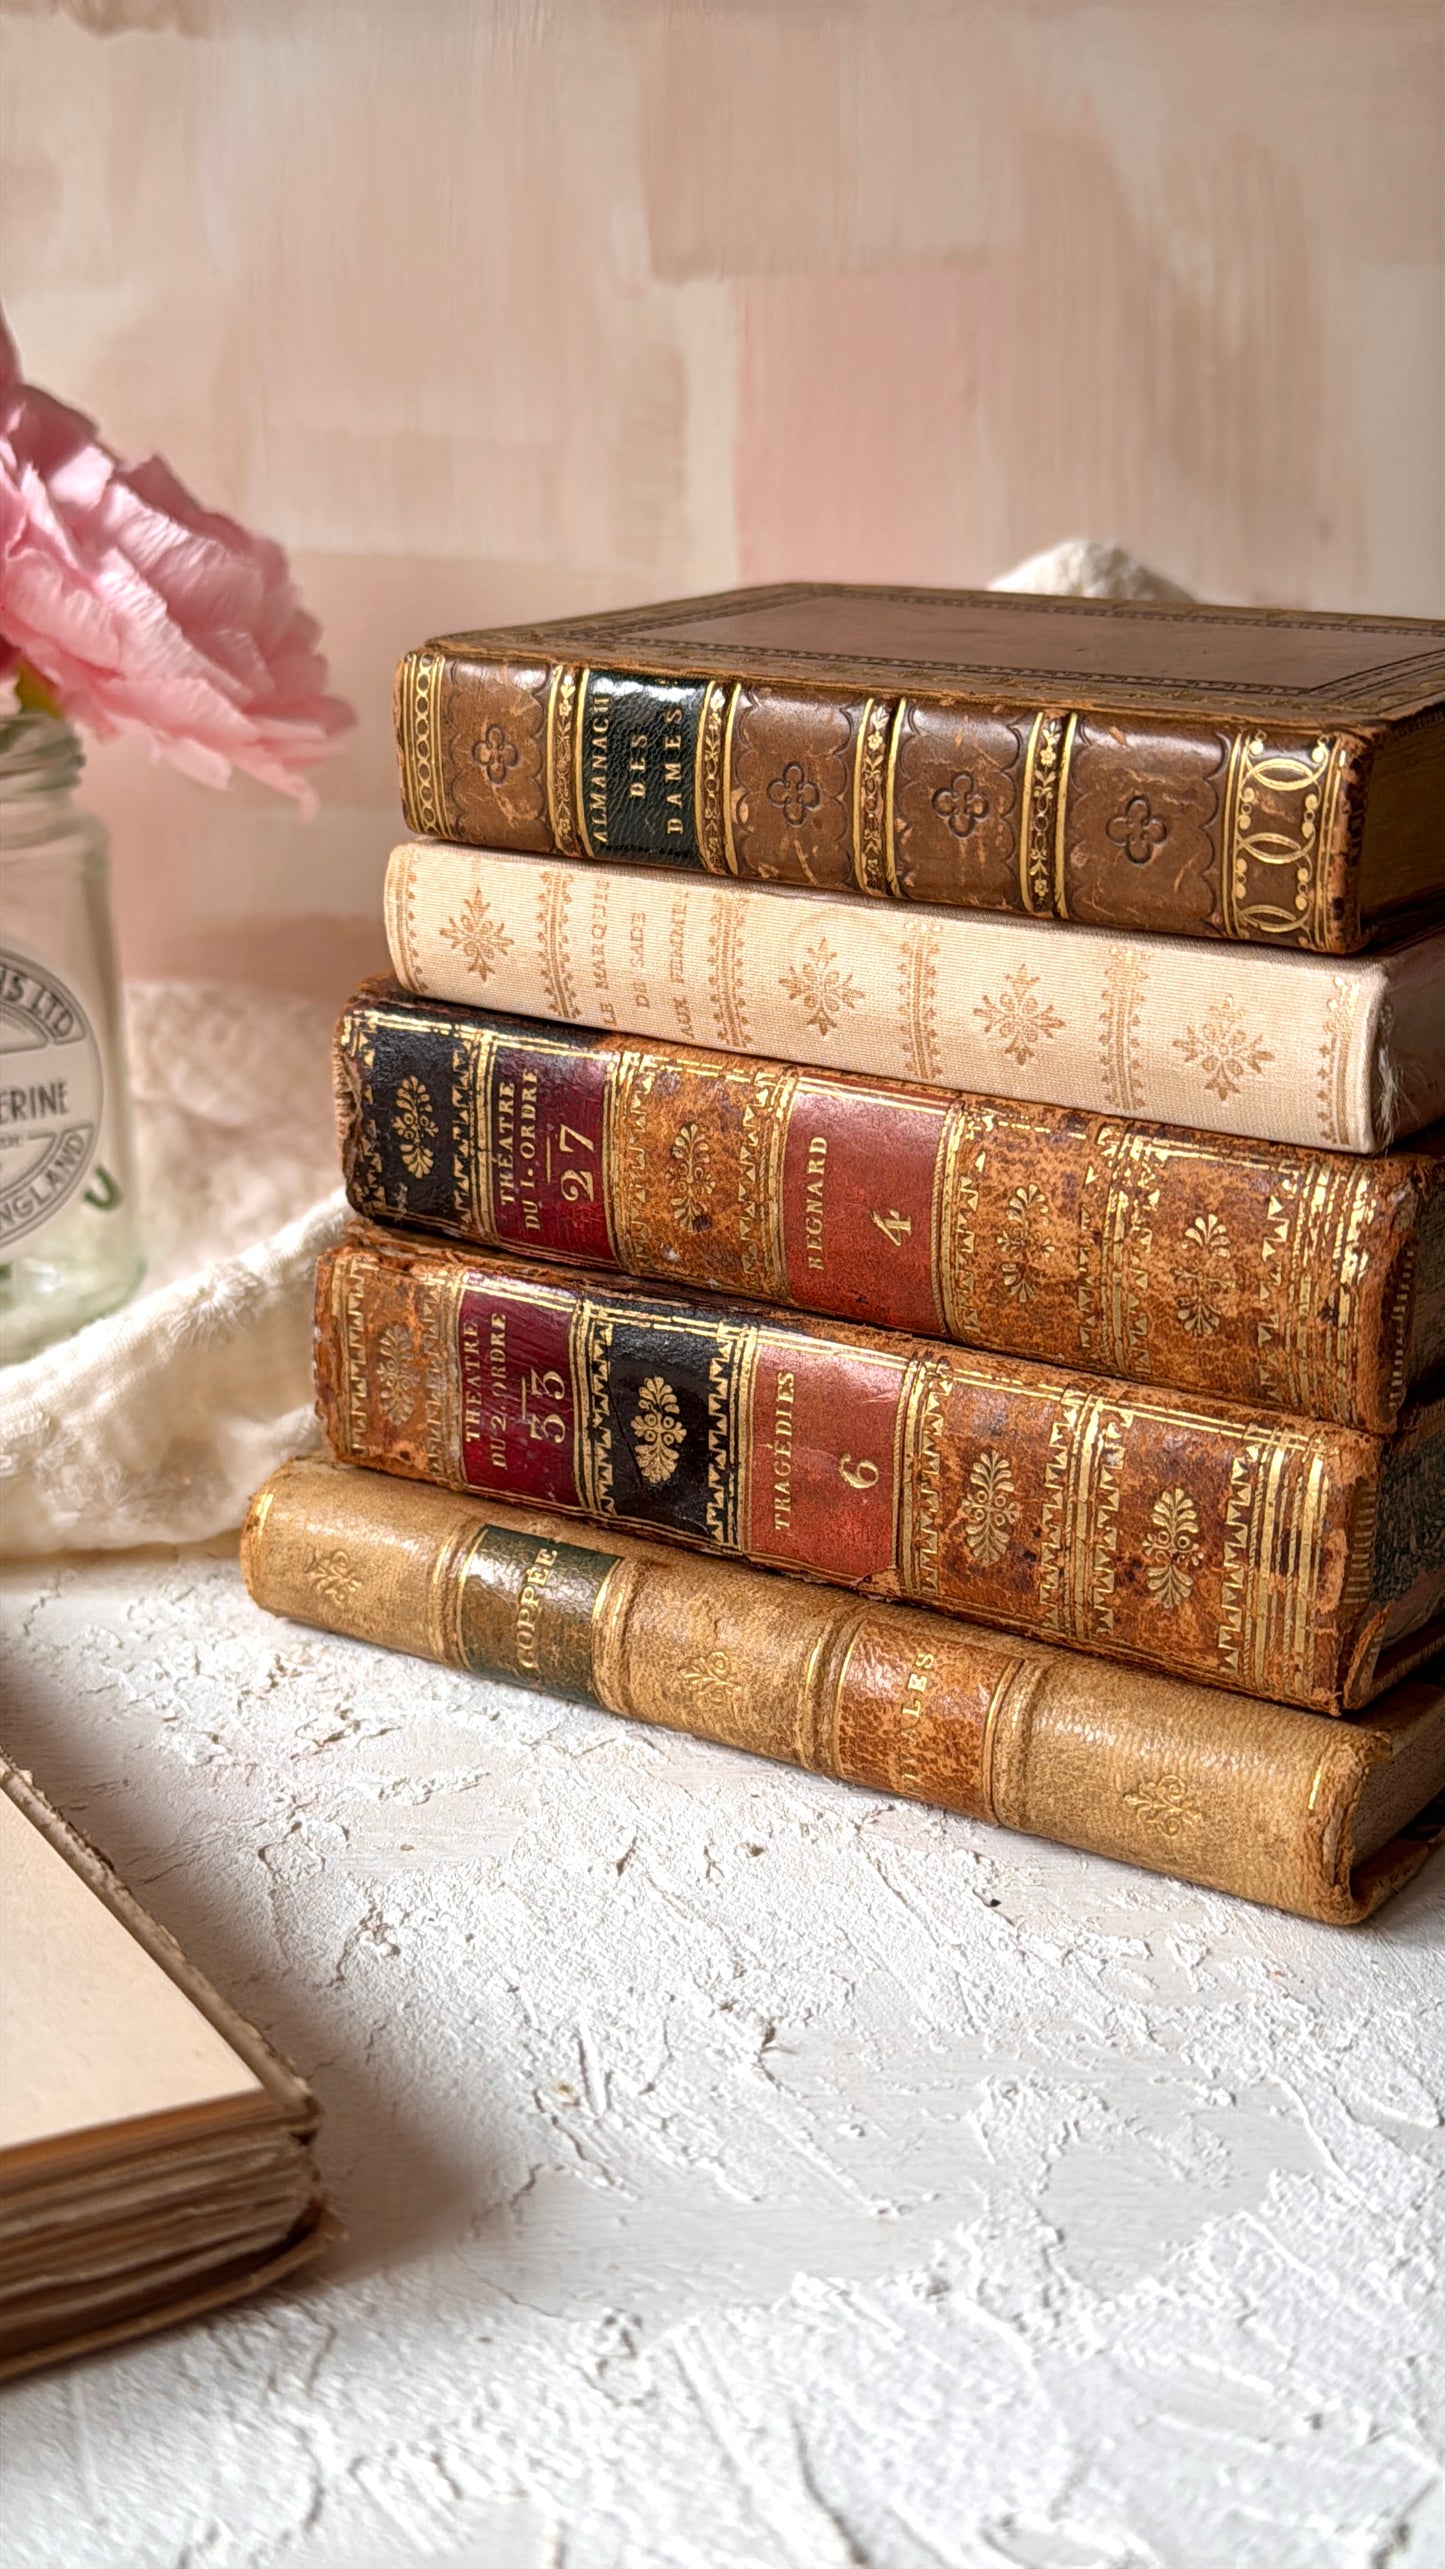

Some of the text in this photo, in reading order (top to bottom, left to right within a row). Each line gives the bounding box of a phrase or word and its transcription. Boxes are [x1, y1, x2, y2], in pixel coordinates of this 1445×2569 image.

[590, 696, 611, 846] ALMANACH
[629, 734, 648, 800] DES
[664, 707, 685, 836] DAMES
[629, 912, 650, 1008] DE SADE
[31, 985, 76, 1039] LTD
[600, 1001, 618, 1027] LE
[673, 996, 695, 1040] AUX
[520, 1067, 540, 1160] ORDRE
[558, 1123, 595, 1202] 27
[521, 1200, 541, 1231] DU
[804, 1136, 828, 1271] REGNARD
[870, 1208, 912, 1247] 4
[463, 1321, 483, 1444] THEATRE
[490, 1312, 507, 1396] ORDRE
[490, 1434, 508, 1471] DU
[767, 1371, 795, 1531] TRAGÉDIES
[838, 1453, 880, 1489] 6
[516, 1547, 559, 1670] COPPÉE
